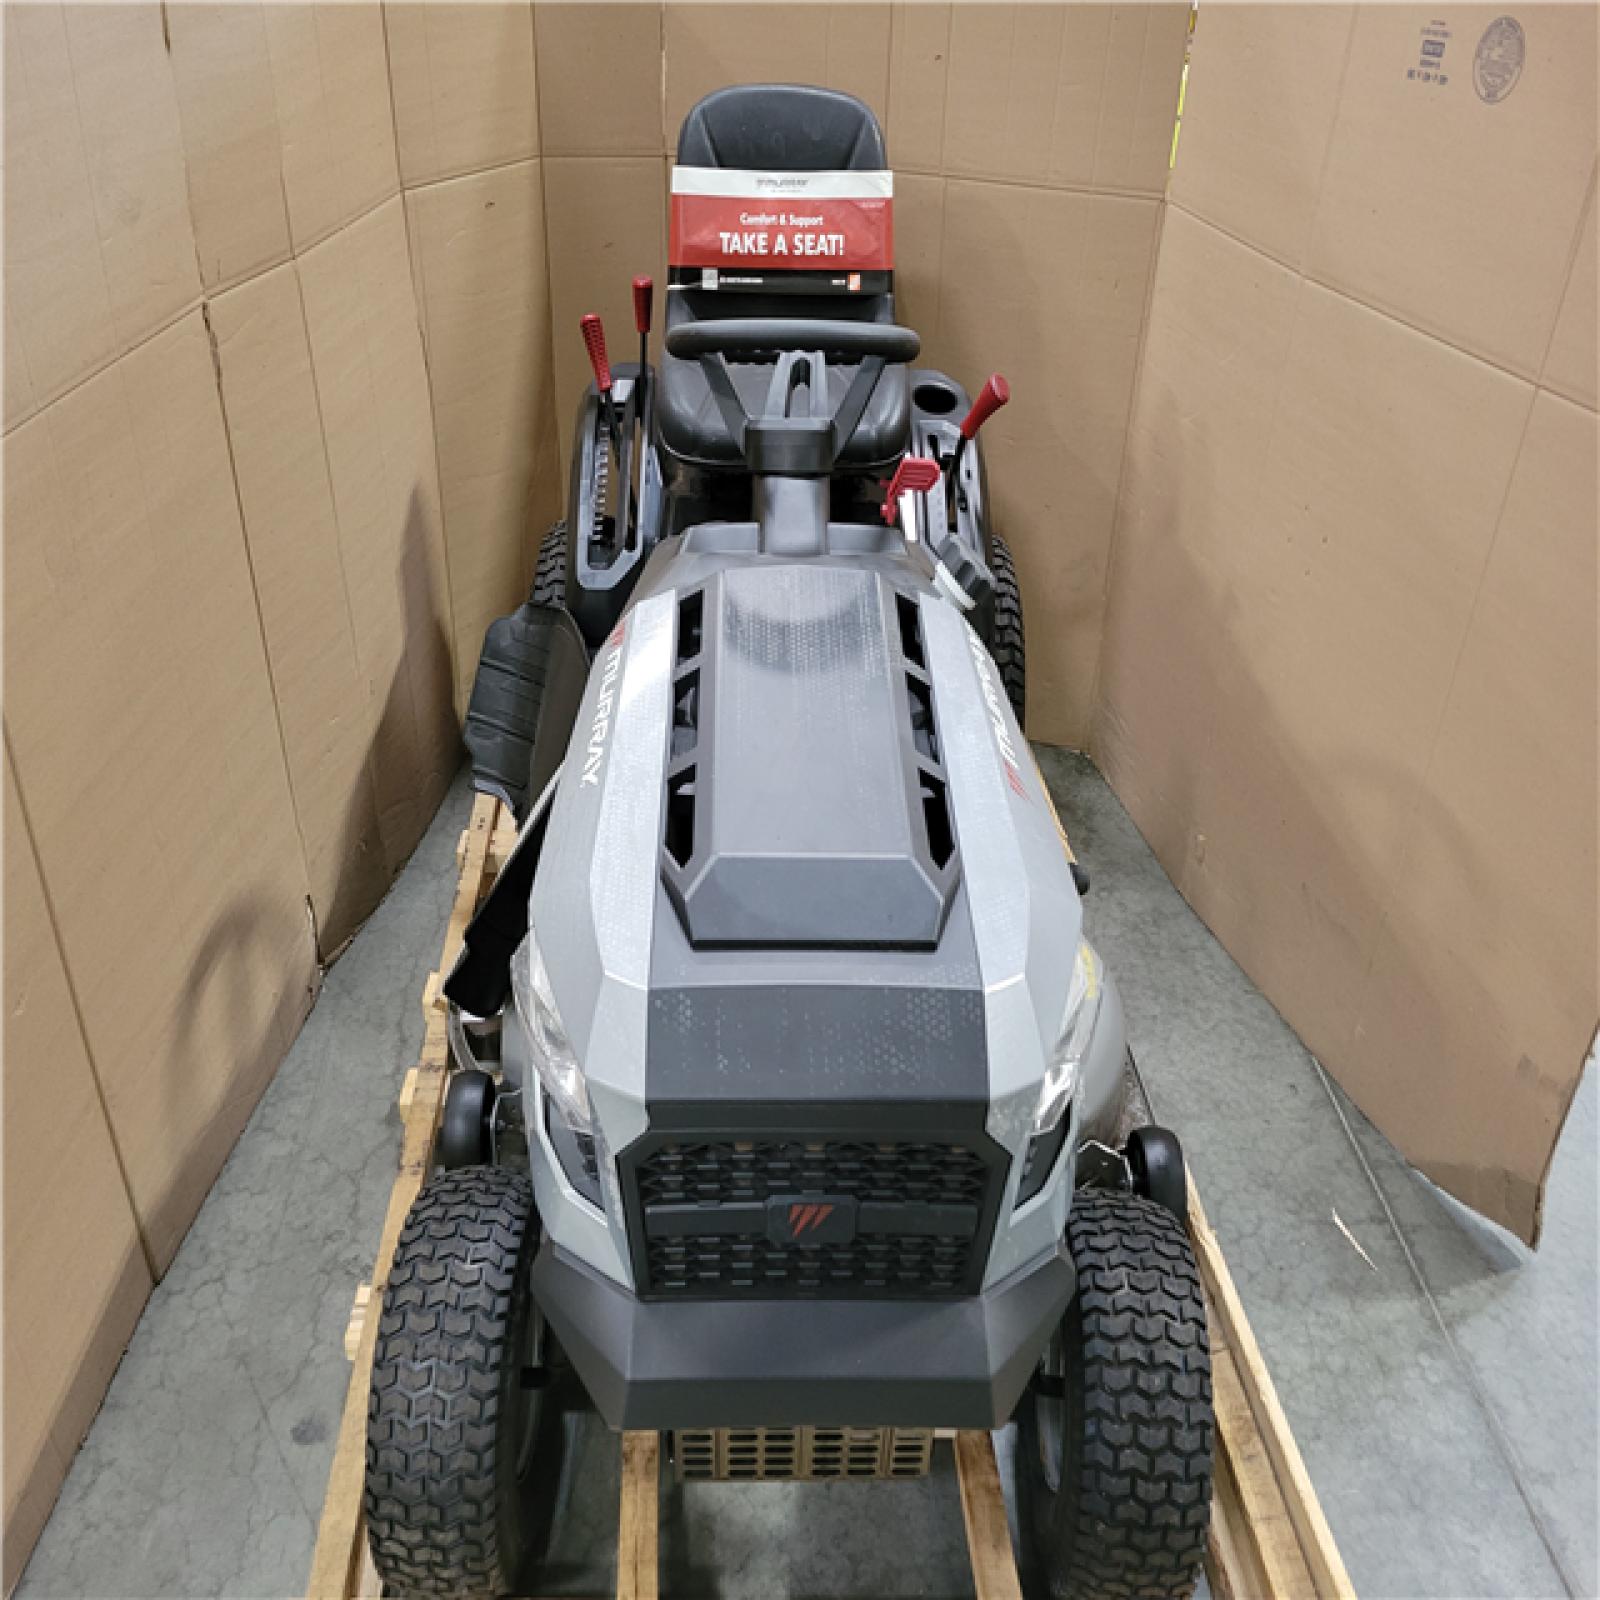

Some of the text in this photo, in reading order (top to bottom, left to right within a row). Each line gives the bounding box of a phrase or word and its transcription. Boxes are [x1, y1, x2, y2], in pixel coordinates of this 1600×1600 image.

[740, 212, 824, 228] Comfort & Support
[719, 232, 845, 256] TAKE A SEAT!
[580, 648, 621, 787] MURRAY
